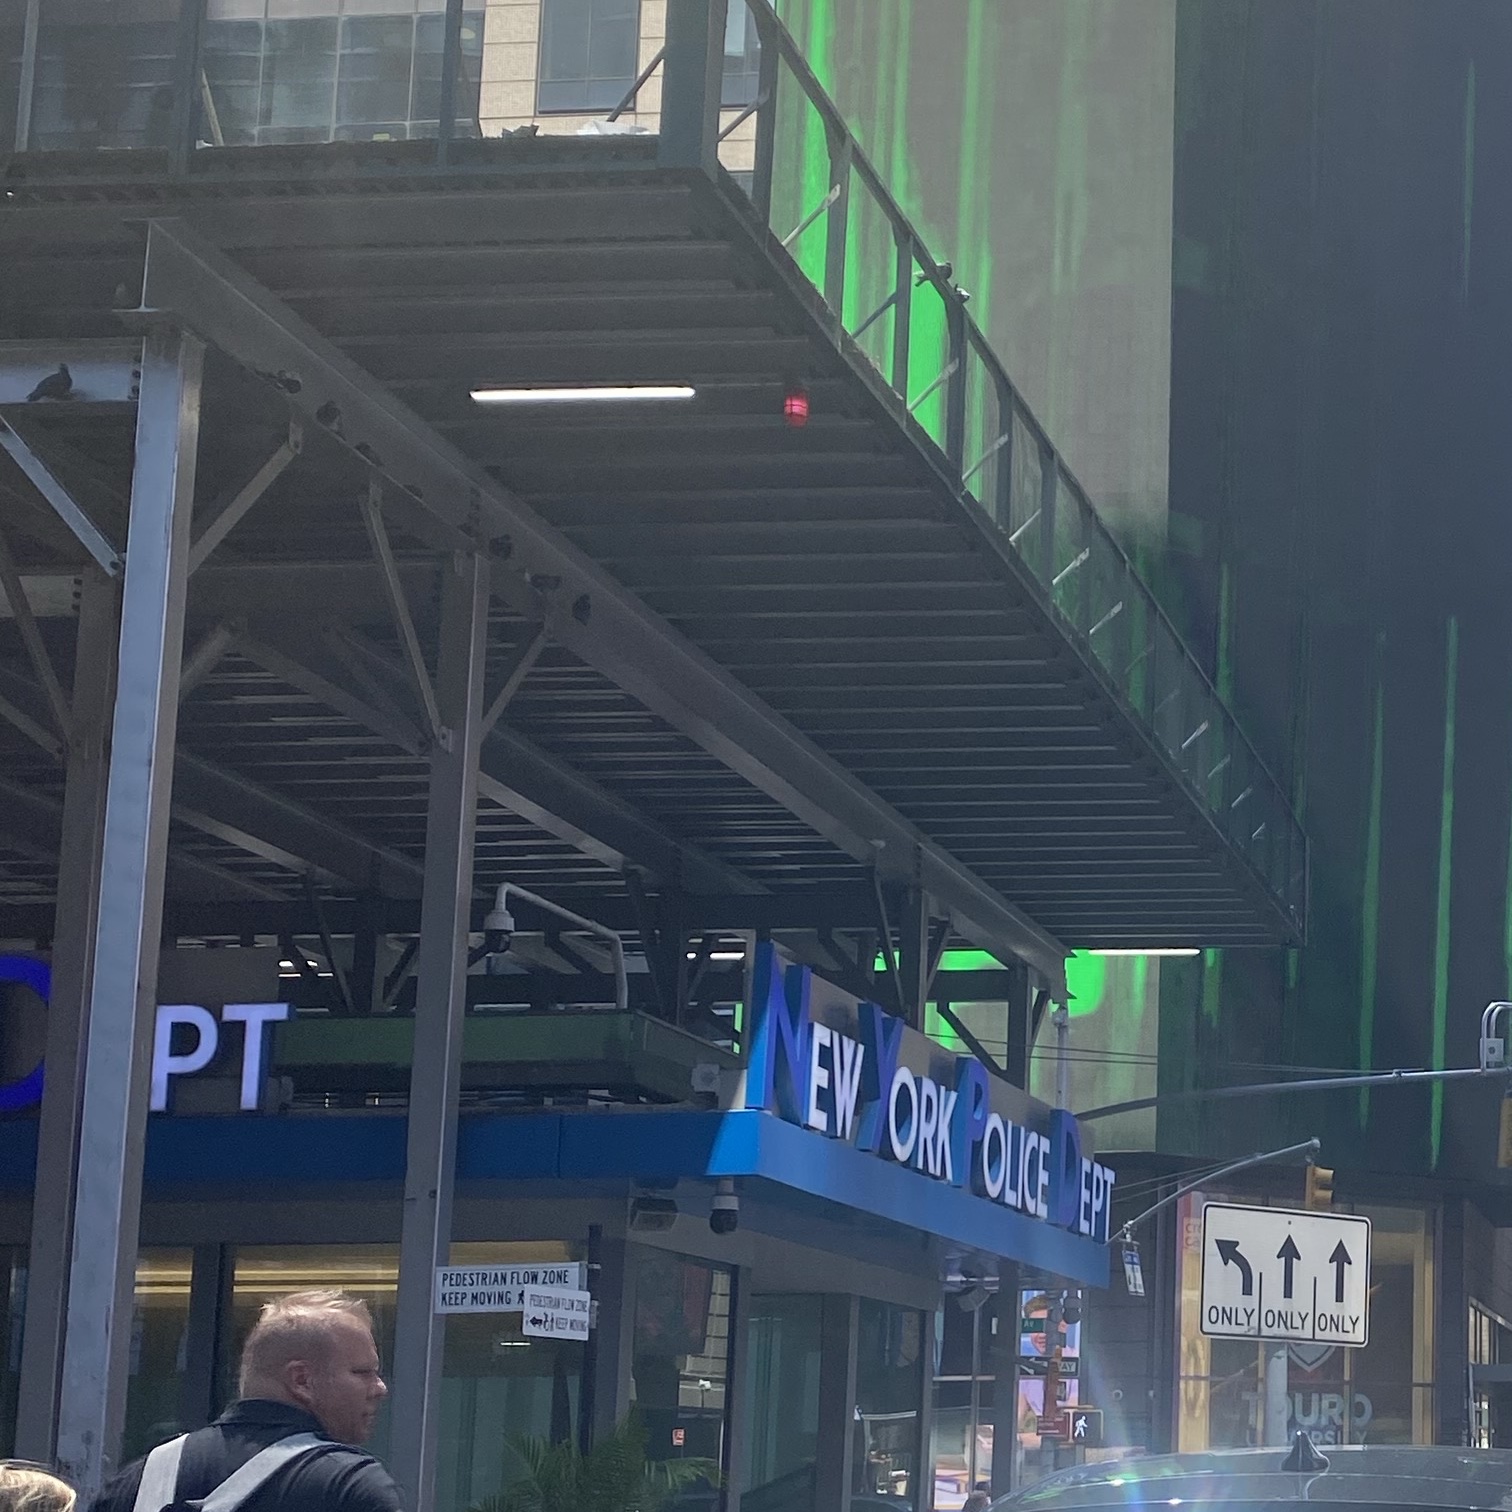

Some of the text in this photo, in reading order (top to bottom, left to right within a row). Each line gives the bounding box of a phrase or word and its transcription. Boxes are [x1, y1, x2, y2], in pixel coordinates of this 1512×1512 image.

[748, 940, 1116, 1243] NEW YORK POLICE DEPT
[442, 1270, 569, 1287] PEDESTRIAN FLOW ZONE
[441, 1291, 512, 1306] KEEP MOVING
[1208, 1305, 1360, 1334] ONLY ONLY ONLY
